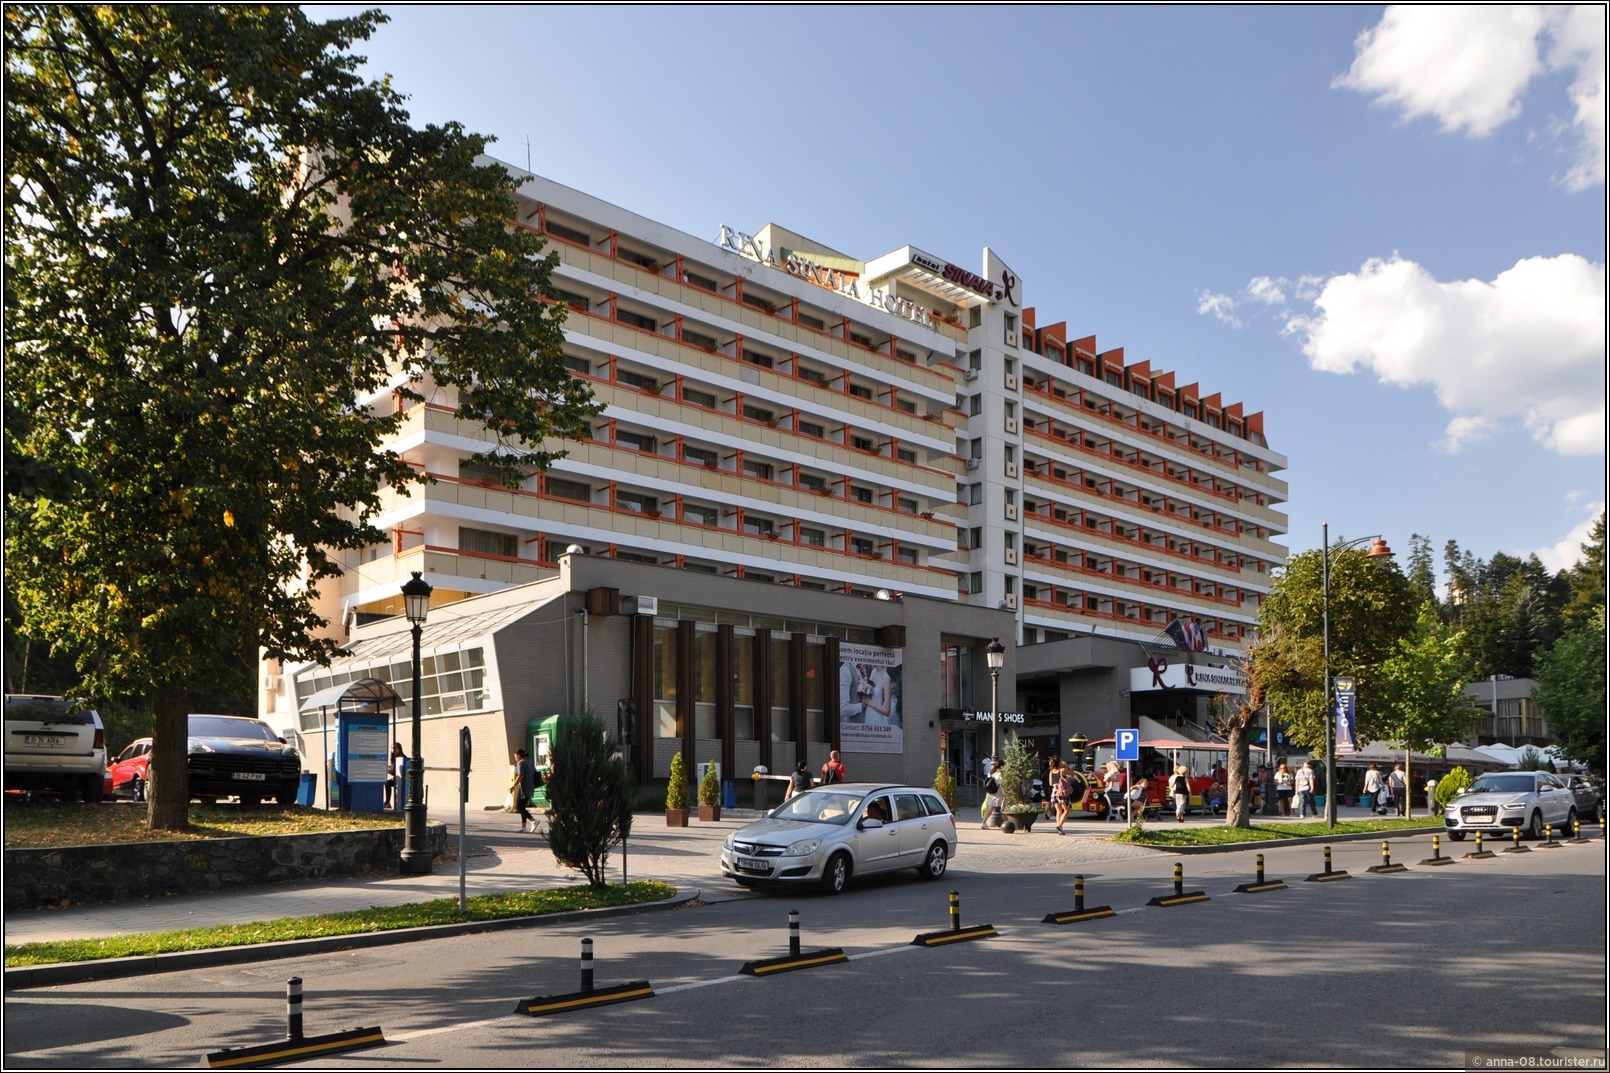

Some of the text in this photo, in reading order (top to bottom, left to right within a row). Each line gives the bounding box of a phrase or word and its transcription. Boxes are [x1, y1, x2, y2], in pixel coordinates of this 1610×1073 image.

[719, 223, 934, 328] RINA SINAIA HOTEL
[942, 263, 994, 297] SINAIA
[1003, 713, 1024, 723] SHOES
[841, 723, 860, 731] Contact:
[861, 724, 873, 732] 0756
[1121, 732, 1134, 750] P
